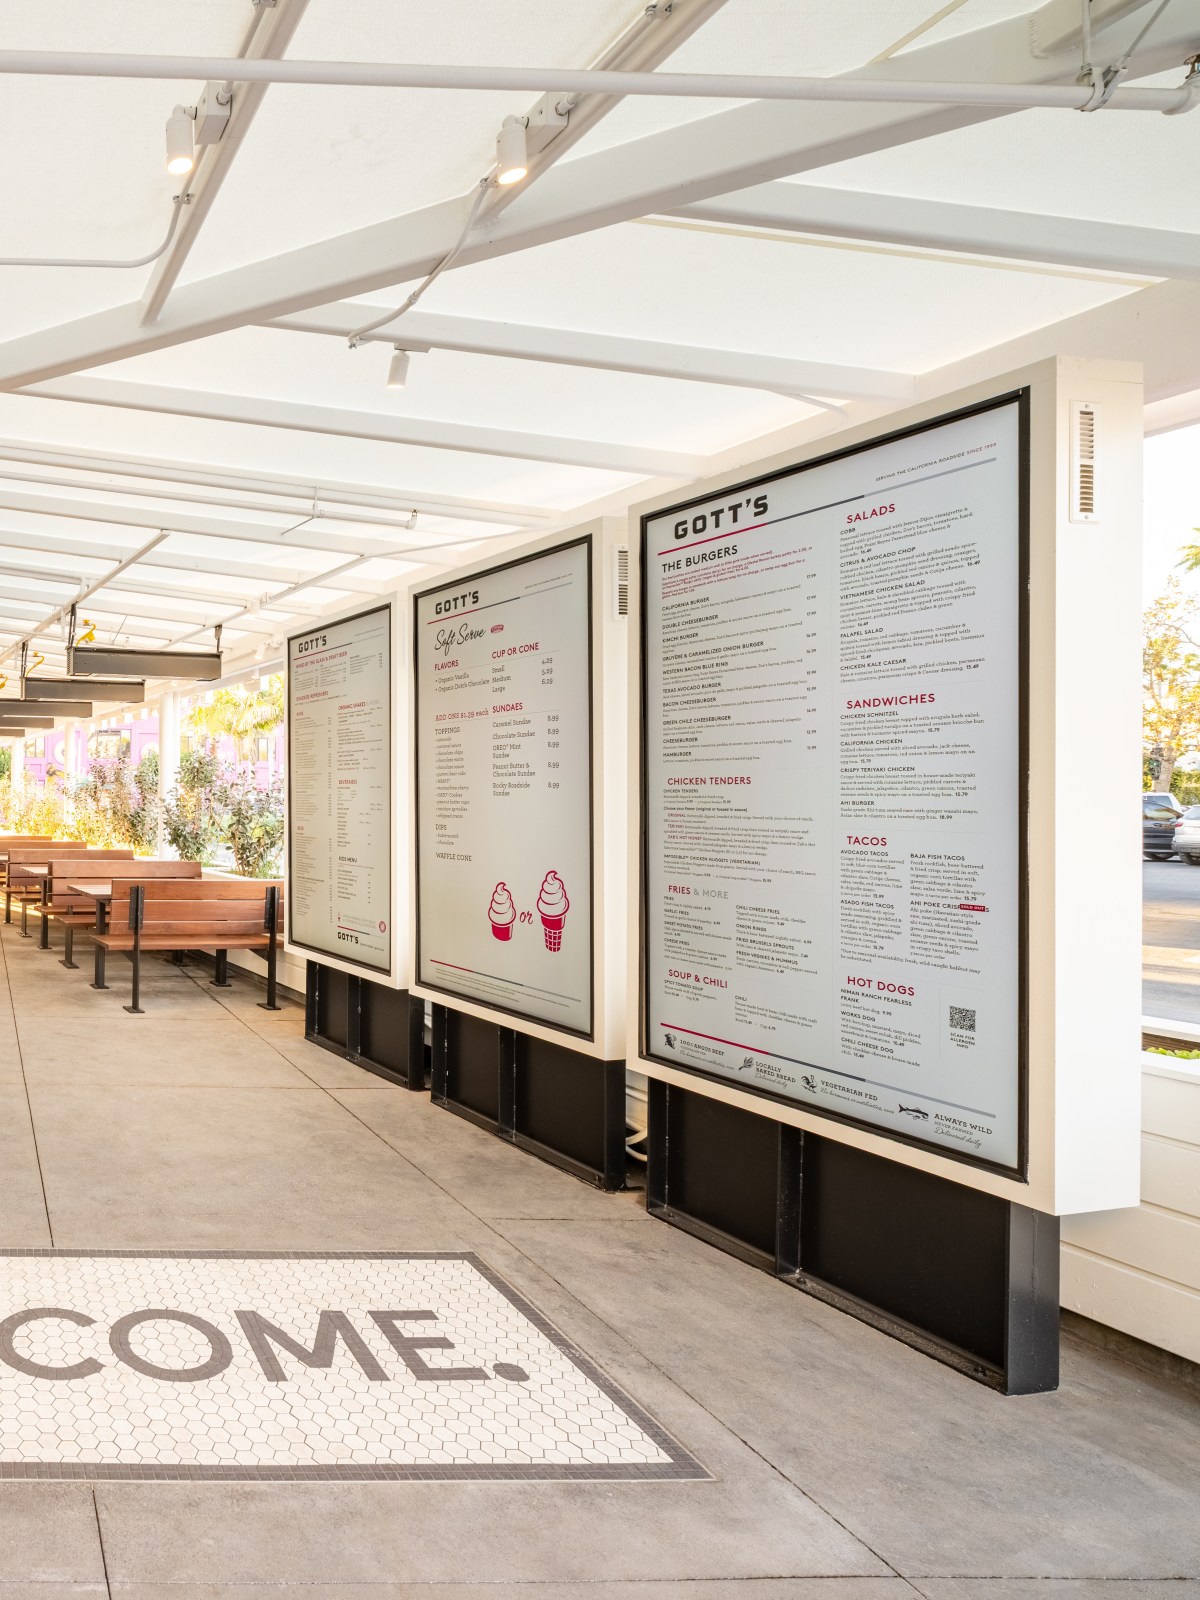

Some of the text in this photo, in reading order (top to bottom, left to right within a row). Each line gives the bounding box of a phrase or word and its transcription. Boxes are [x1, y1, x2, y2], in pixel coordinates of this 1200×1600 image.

[876, 473, 896, 482] SERVING
[907, 460, 937, 472] CALIFORNIA
[939, 452, 965, 463] ROADSIDE
[674, 494, 769, 540] GOTT'S
[846, 504, 896, 524] SALADS
[686, 545, 738, 567] BURGERS
[840, 559, 860, 568] CITRUS
[866, 551, 896, 562] AVOCADO
[898, 547, 916, 555] CHOP
[840, 580, 925, 600] VIETNAMESE CHICKEN SALAD
[435, 591, 479, 615] GOTT'S
[435, 623, 486, 656] Soft Serve
[840, 630, 863, 638] FALAFEL
[299, 635, 326, 653] GOTT'S
[492, 649, 505, 659] CUP
[518, 642, 539, 653] CONE
[435, 660, 458, 671] FLAVORS
[492, 702, 522, 713] SUNDAES
[846, 693, 936, 709] SANDWICHES
[710, 776, 751, 785] TENDERS
[847, 836, 887, 846] TACOS
[702, 889, 729, 899] MORE
[519, 911, 533, 924] or
[338, 932, 358, 944] GOTT'S
[668, 969, 691, 980] SOUP
[847, 976, 915, 996] HOT DOGS
[841, 988, 912, 1006] NIMAN RANCH FEARLESS
[841, 1011, 862, 1020] WORKS
[858, 1042, 879, 1050] CHEESE
[934, 1113, 992, 1135] ALWAYS WILD
